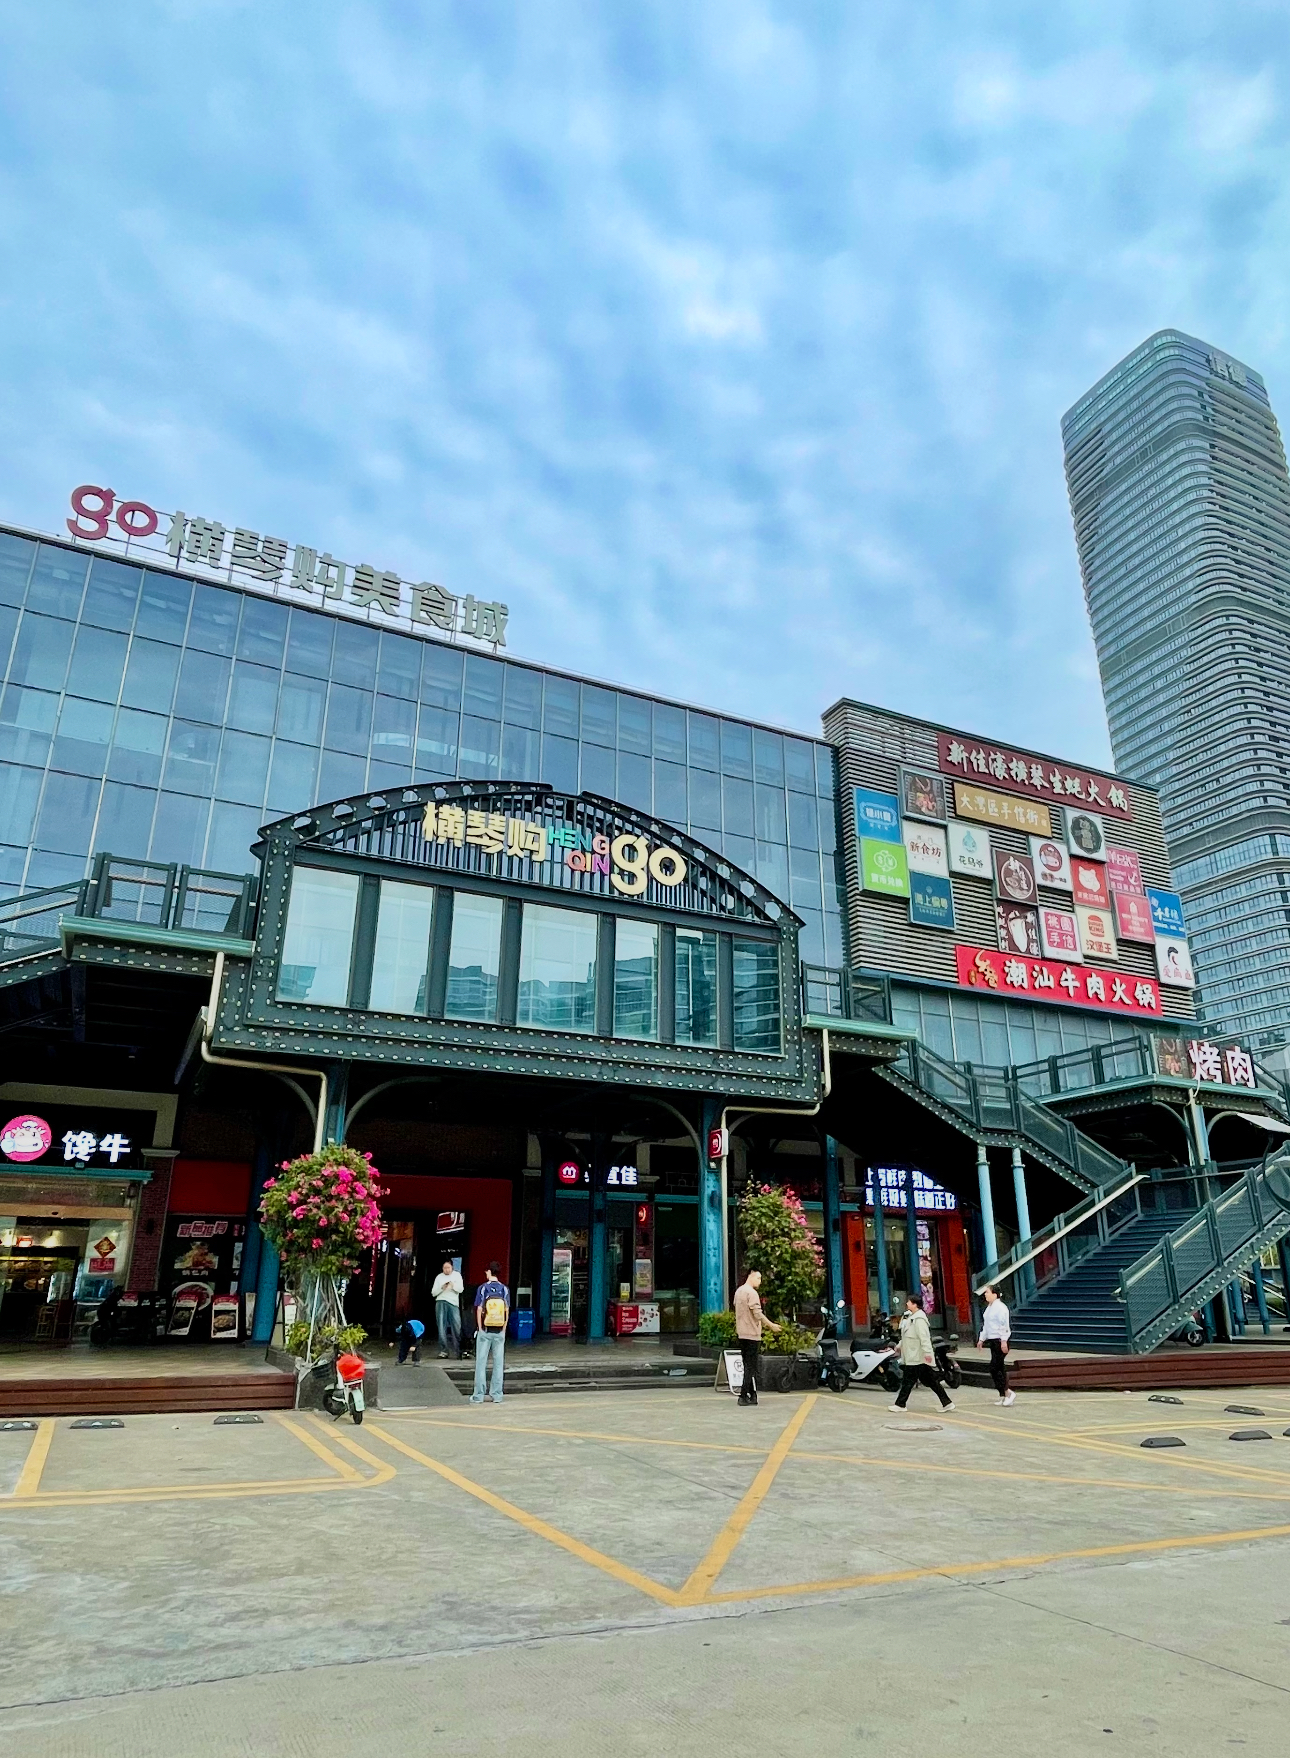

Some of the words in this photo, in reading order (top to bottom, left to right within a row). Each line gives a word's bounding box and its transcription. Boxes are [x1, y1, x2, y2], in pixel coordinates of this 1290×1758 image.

[66, 485, 158, 540] go
[165, 510, 509, 646] 横琴购美食城
[422, 801, 547, 862] 横琴购
[548, 826, 610, 855] HENG
[567, 849, 610, 876] QIN
[610, 834, 687, 895] go
[1086, 939, 1112, 955] 汉堡王
[1003, 958, 1157, 1009] 潮汕牛肉火锅
[1188, 1040, 1256, 1088] 烤肉
[62, 1130, 131, 1162] 馋牛
